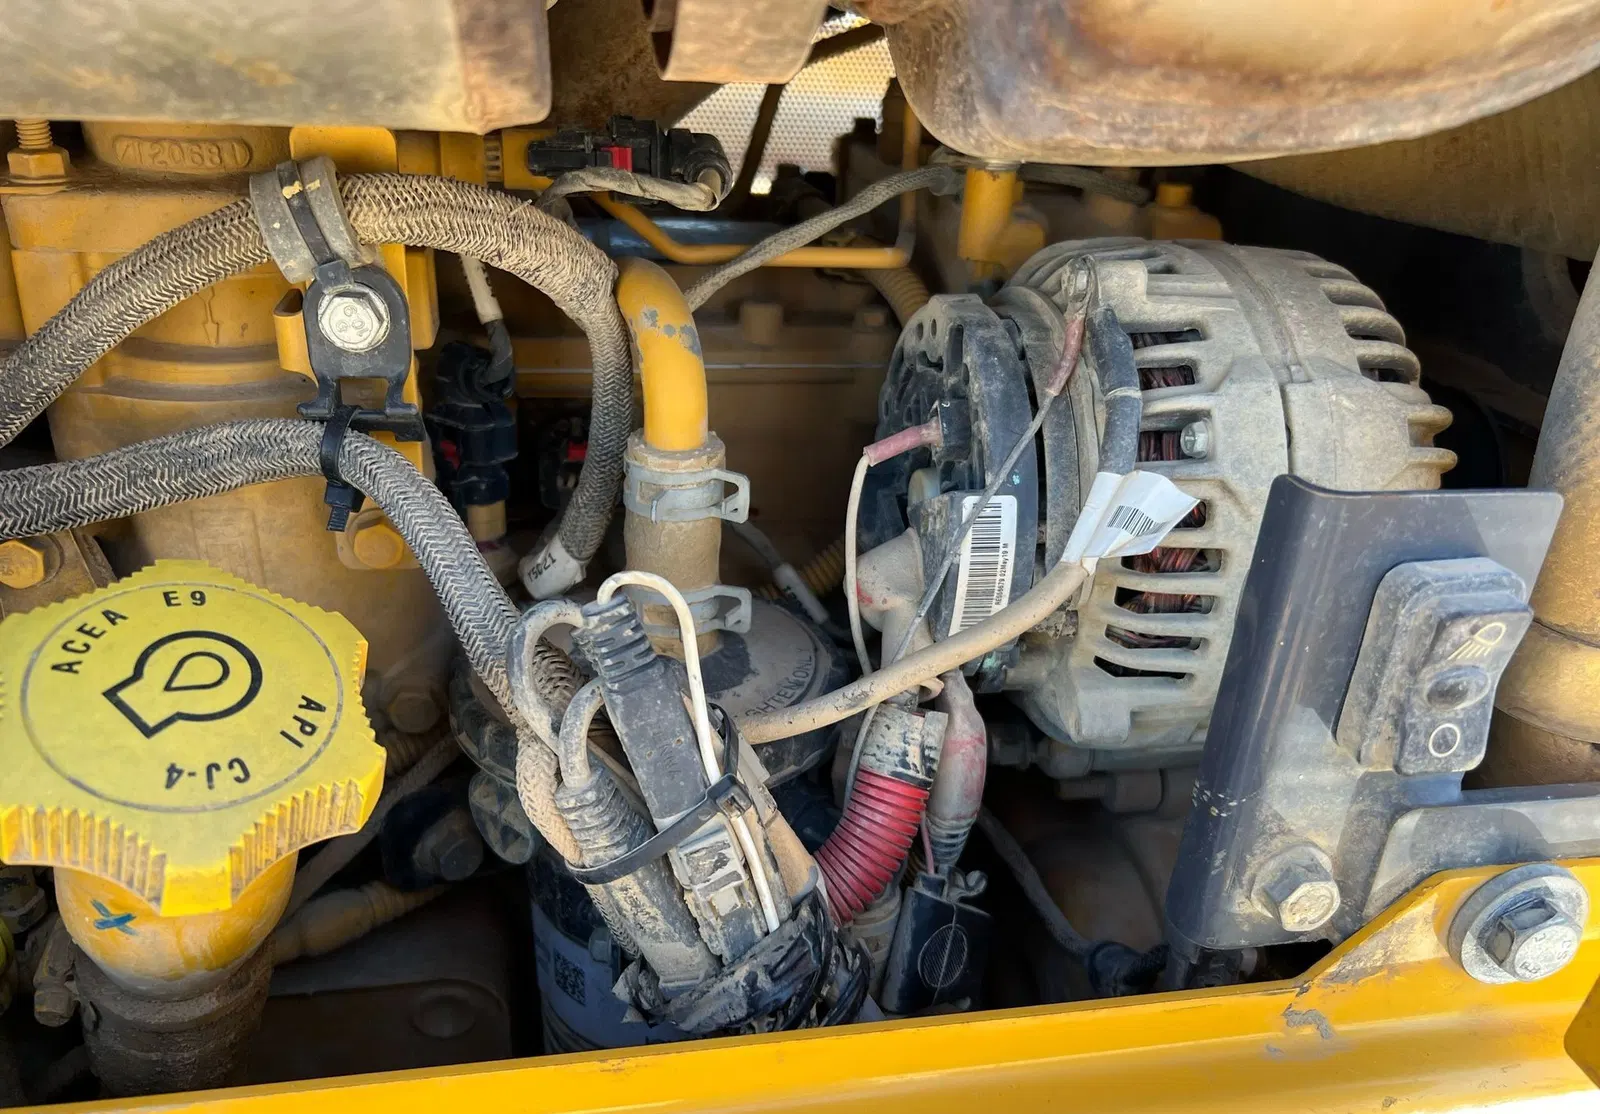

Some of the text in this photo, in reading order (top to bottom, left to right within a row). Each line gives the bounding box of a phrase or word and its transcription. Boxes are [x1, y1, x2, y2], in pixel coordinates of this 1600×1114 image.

[51, 589, 207, 675] ACEA E9
[164, 694, 327, 790] API CJ-4
